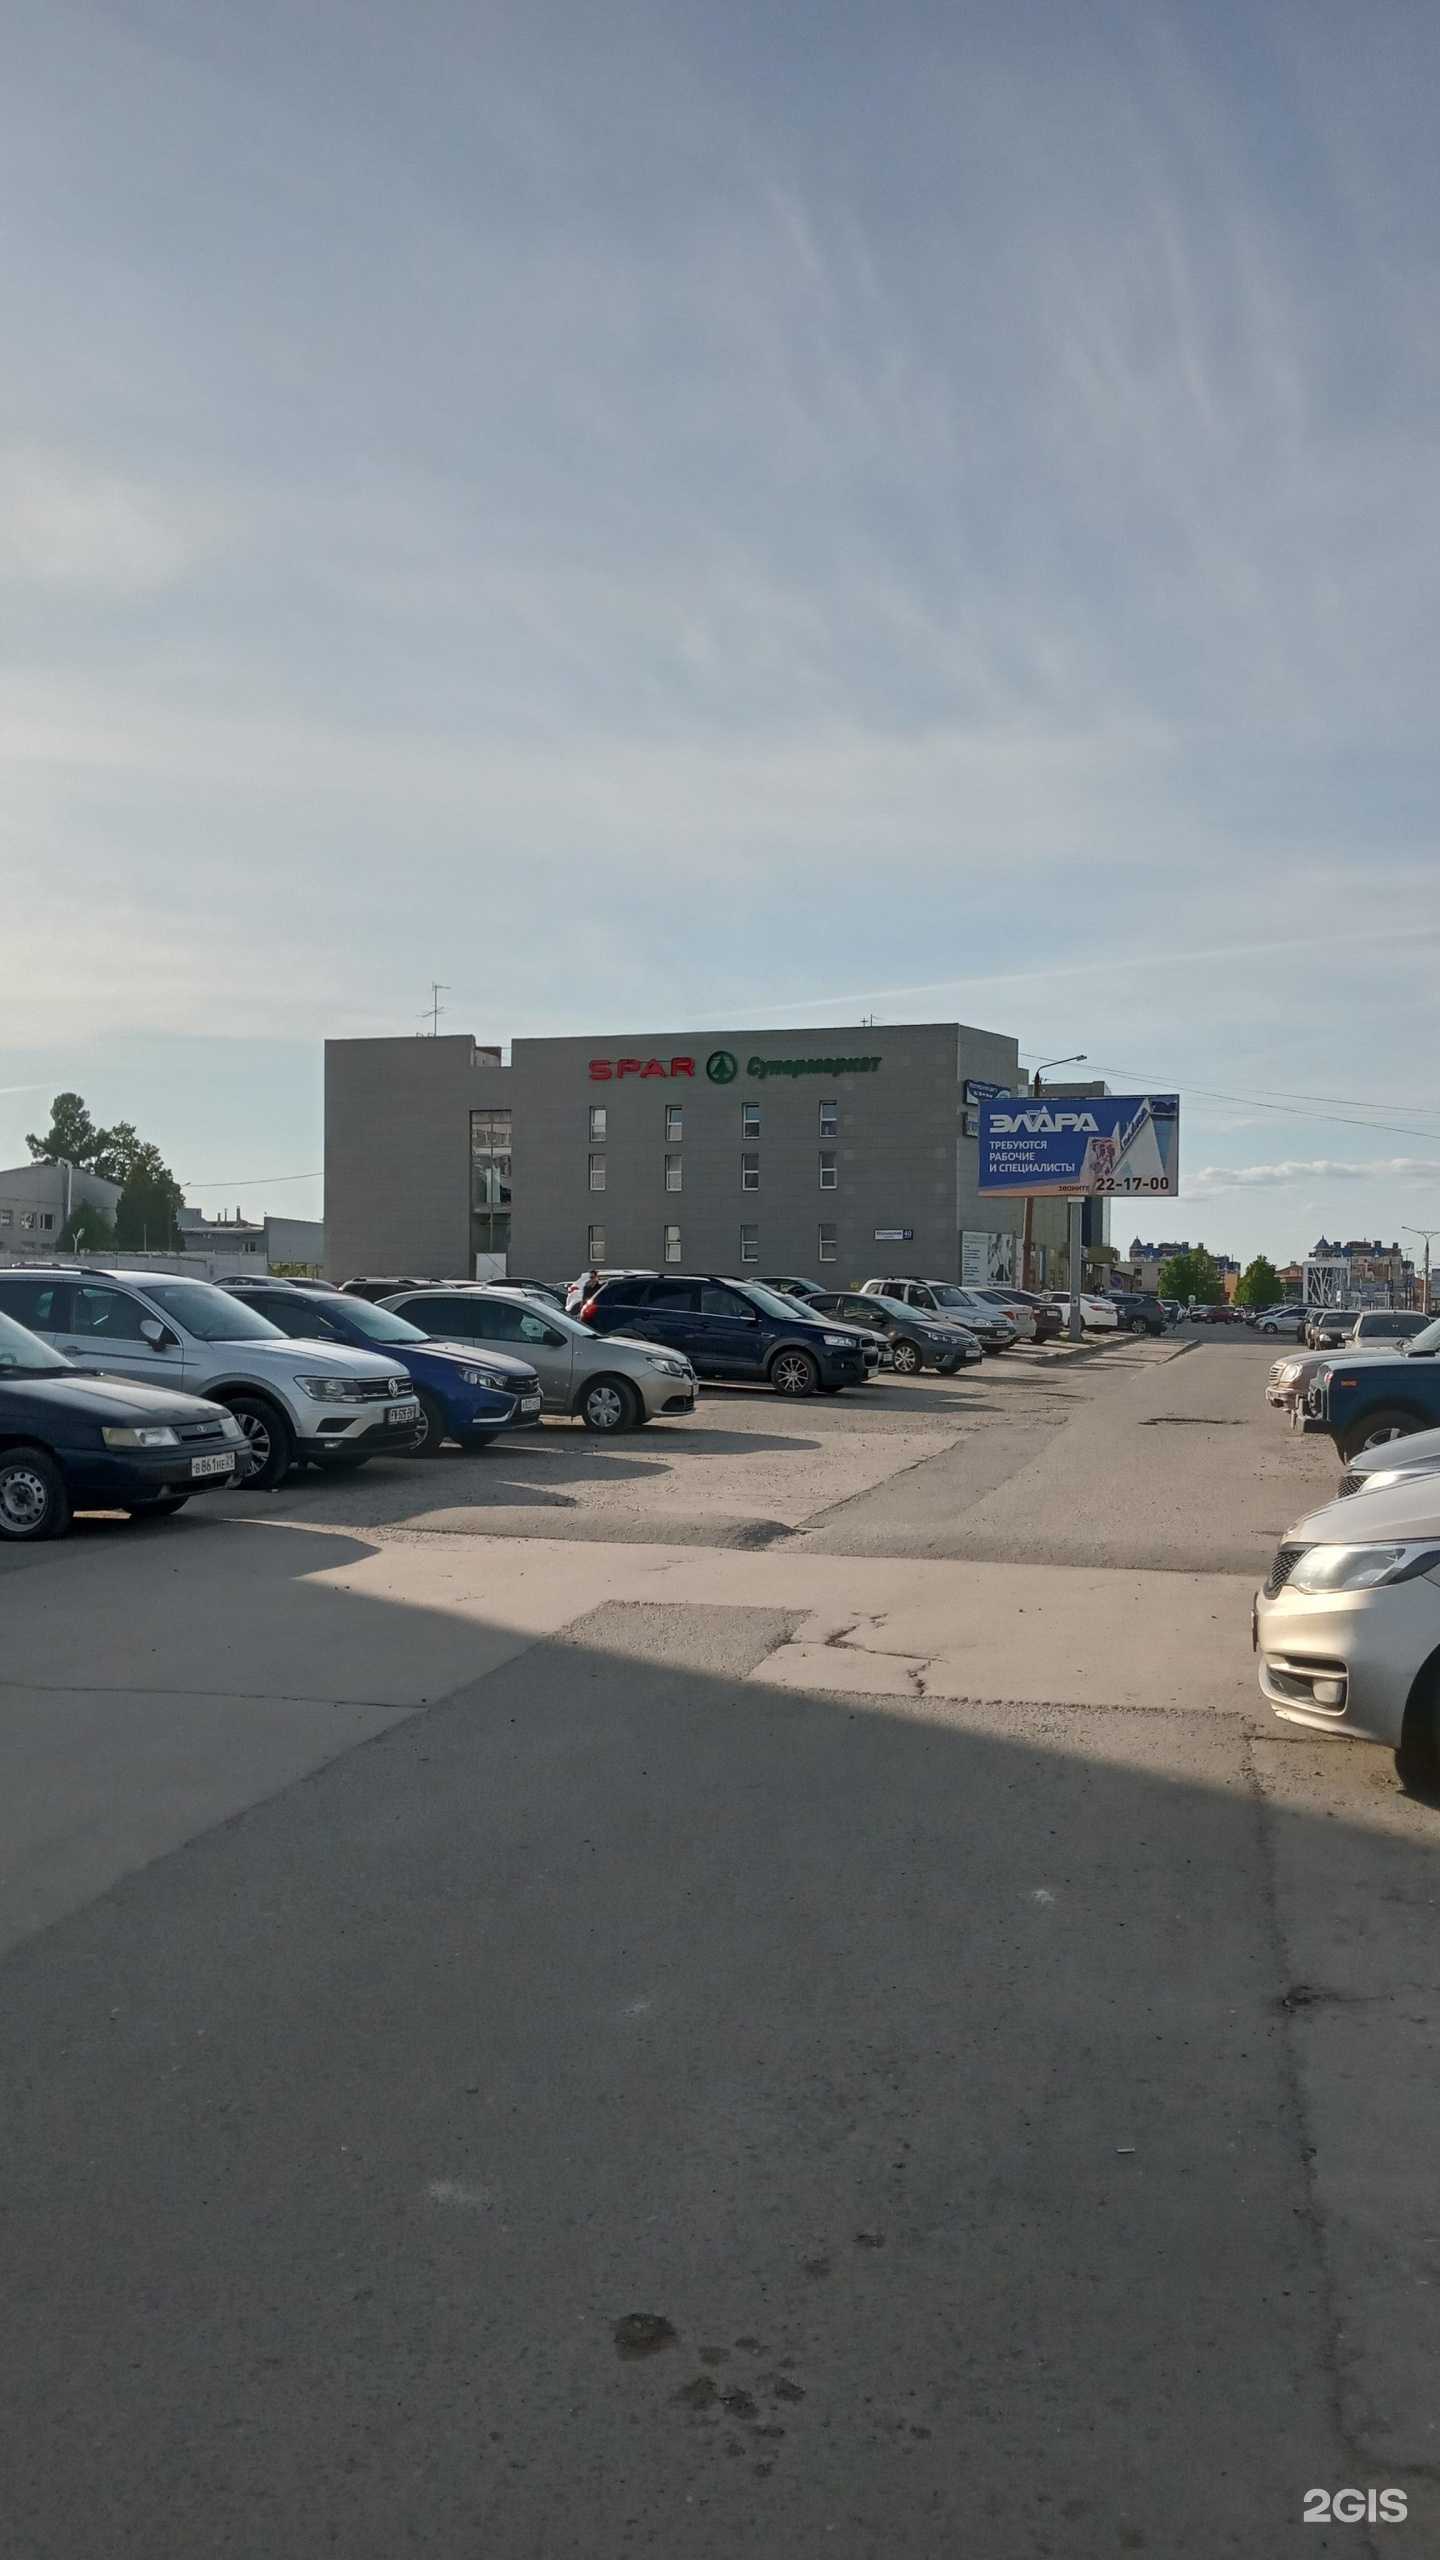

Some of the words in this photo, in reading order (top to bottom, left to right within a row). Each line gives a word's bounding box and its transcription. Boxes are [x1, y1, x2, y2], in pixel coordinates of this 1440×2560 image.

[588, 1057, 696, 1081] SPAR
[747, 1056, 883, 1079] Супермаркет
[989, 1105, 1100, 1133] ЭЛАРА
[989, 1140, 1048, 1151] ТРЕБУЮТСЯ
[989, 1151, 1036, 1162] РАБОЧИЕ
[989, 1163, 997, 1173] И
[1000, 1162, 1076, 1174] СПЕЦИАЛИСТЫ
[1096, 1176, 1170, 1192] 22-17-00
